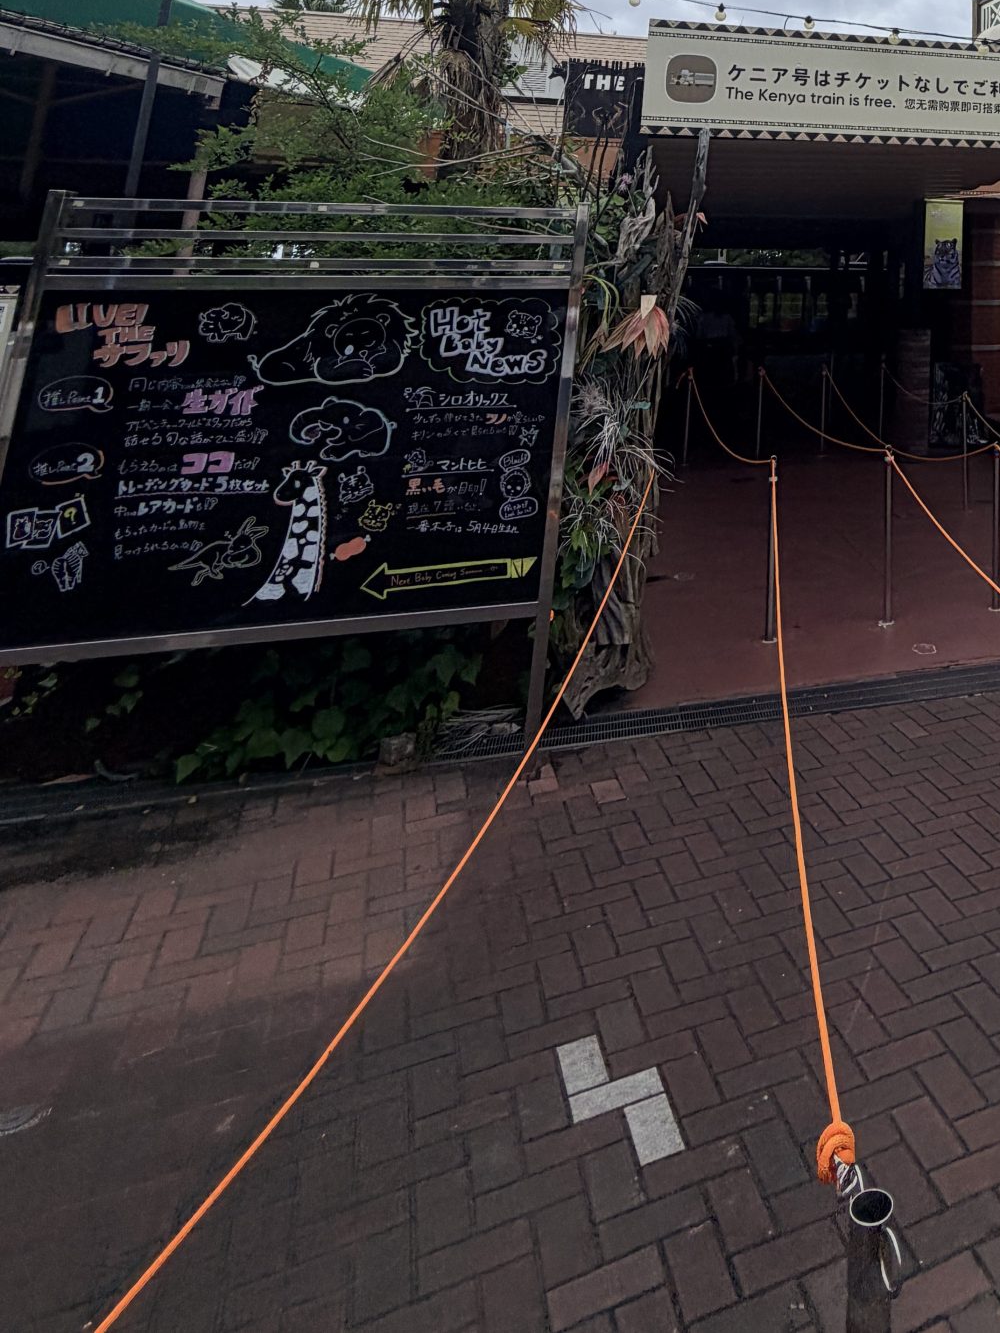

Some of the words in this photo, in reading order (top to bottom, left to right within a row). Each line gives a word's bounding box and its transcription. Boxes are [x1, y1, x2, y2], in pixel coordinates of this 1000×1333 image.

[582, 74, 625, 91] THE
[725, 86, 754, 100] The
[758, 89, 806, 106] Kenya
[811, 92, 845, 106] train
[849, 93, 860, 106] is
[864, 95, 896, 108] free.
[429, 307, 492, 338] Hot
[98, 324, 156, 345] THE
[440, 332, 505, 357] Baby
[438, 390, 509, 407] シロオリックス
[436, 457, 488, 471] マントヒヒ
